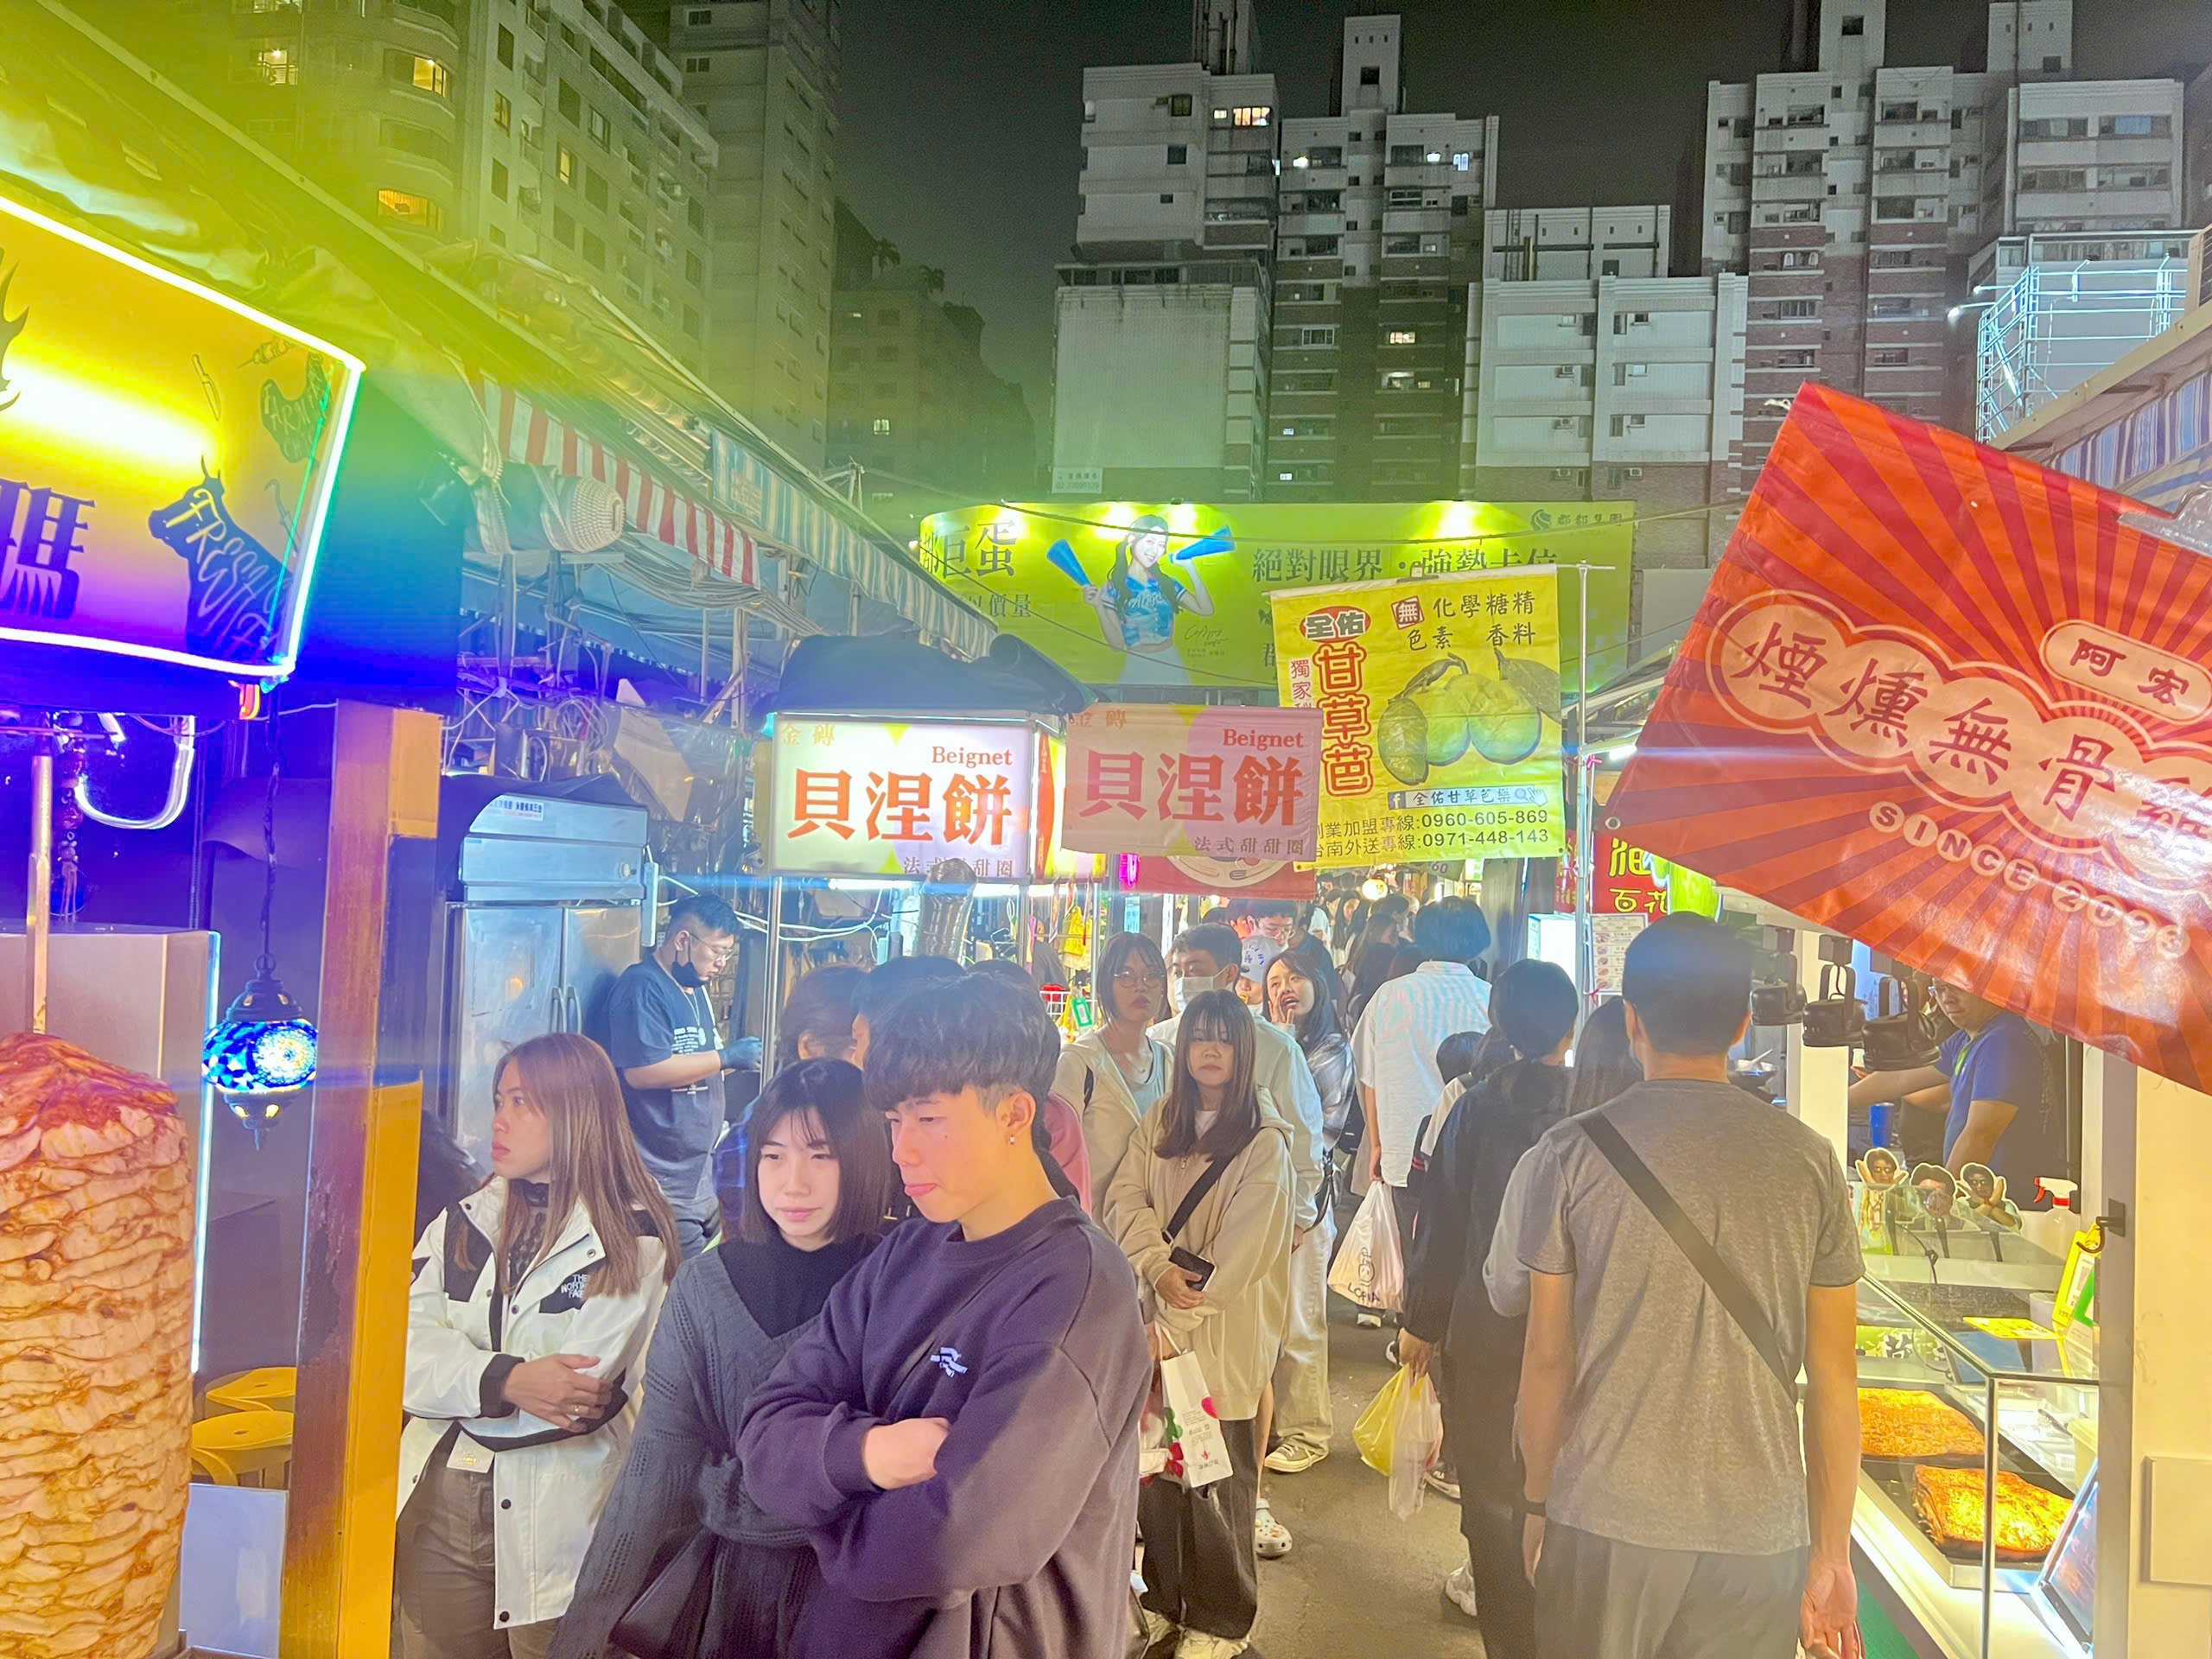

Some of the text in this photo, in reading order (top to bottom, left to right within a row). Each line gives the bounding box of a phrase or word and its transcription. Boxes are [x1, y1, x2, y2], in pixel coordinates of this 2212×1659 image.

[1408, 623, 1535, 651] 色素 香料
[1223, 728, 1305, 750] Beignet
[1313, 642, 1373, 797] 甘草芭
[931, 747, 1013, 767] Beignet
[787, 768, 1013, 846] 貝涅餅
[1079, 750, 1304, 827] 貝涅餅
[1194, 836, 1304, 855] 法式甜甜圈
[1876, 805, 2034, 887] SINCE
